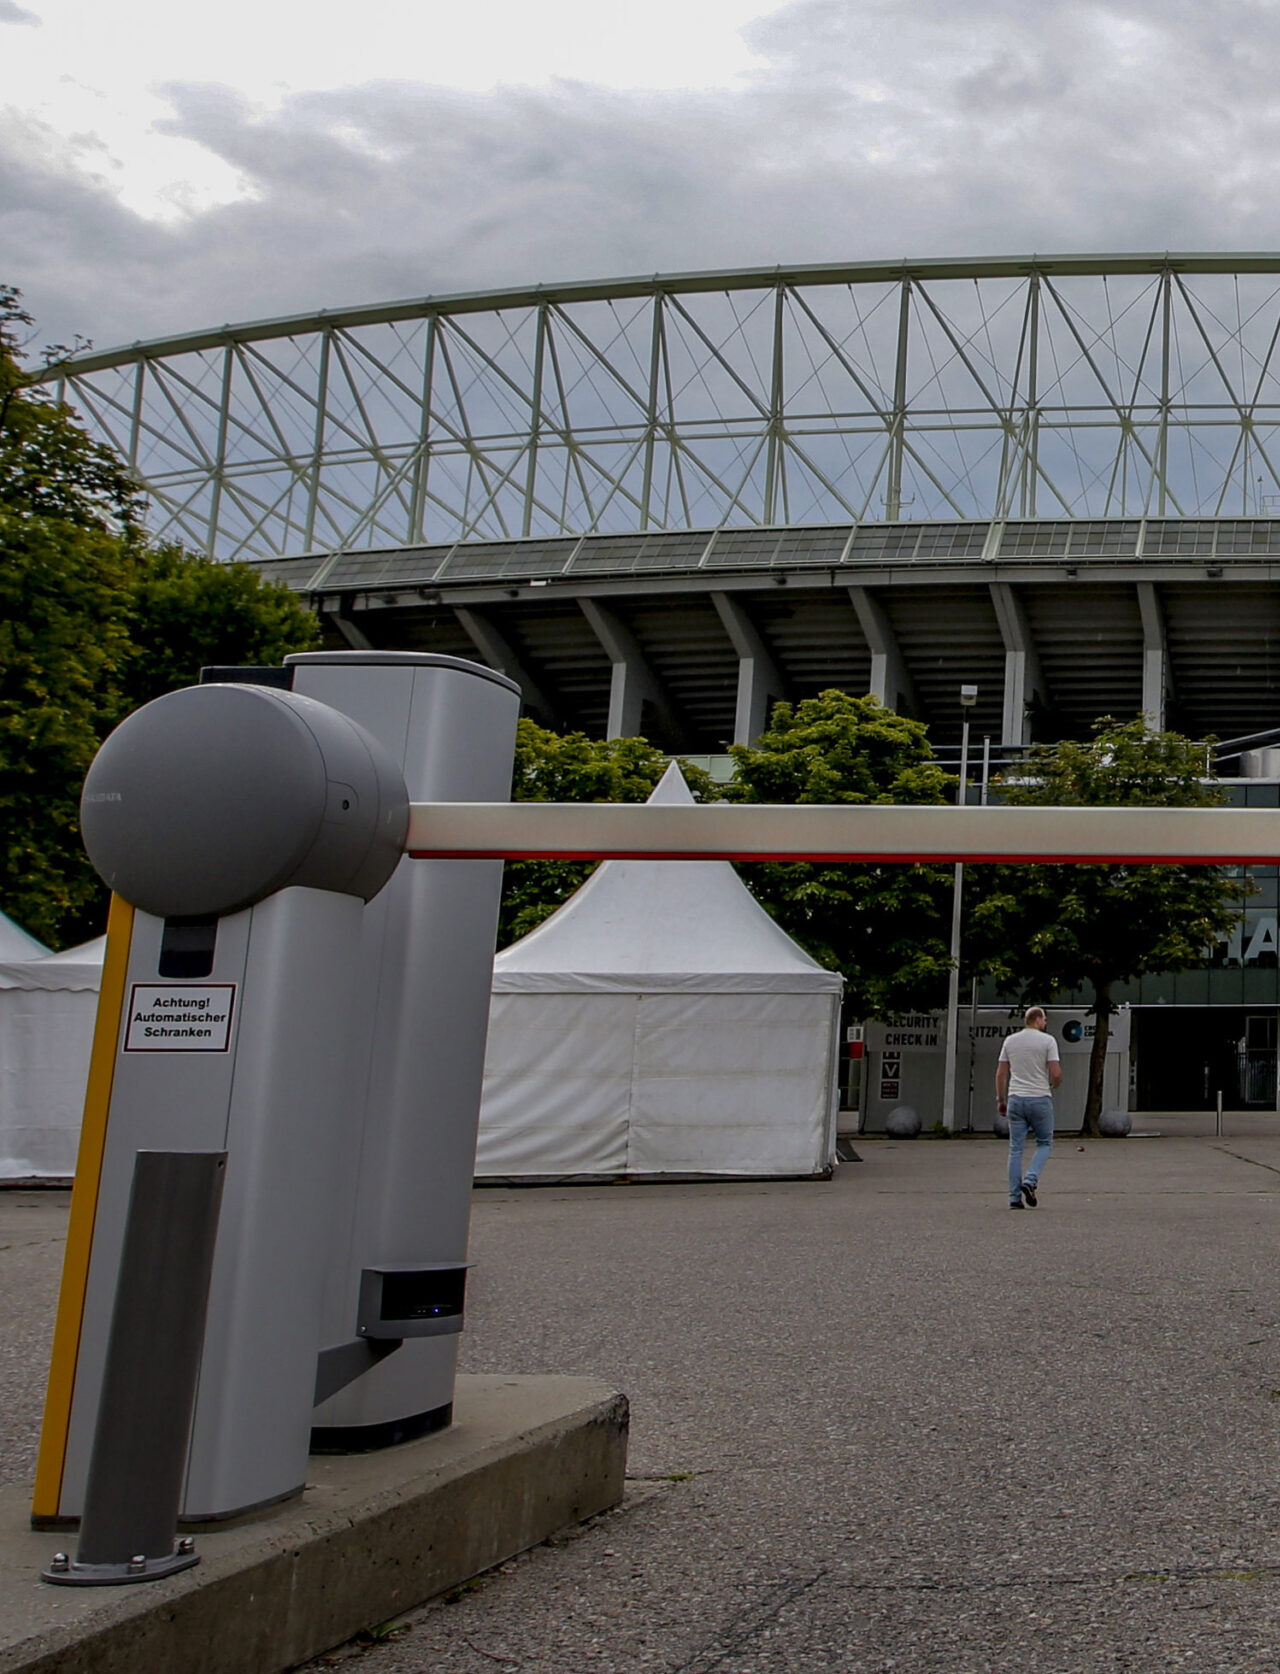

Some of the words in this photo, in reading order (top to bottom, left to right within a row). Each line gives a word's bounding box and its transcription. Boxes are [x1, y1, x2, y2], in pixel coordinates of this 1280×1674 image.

[153, 998, 210, 1009] Achtung!
[133, 1012, 226, 1023] Automatischer
[886, 1015, 939, 1028] SECURITY
[144, 1027, 212, 1038] Schranken
[969, 1026, 1025, 1038] ITZPLAT
[885, 1033, 922, 1046] CHECK
[925, 1034, 937, 1046] IN
